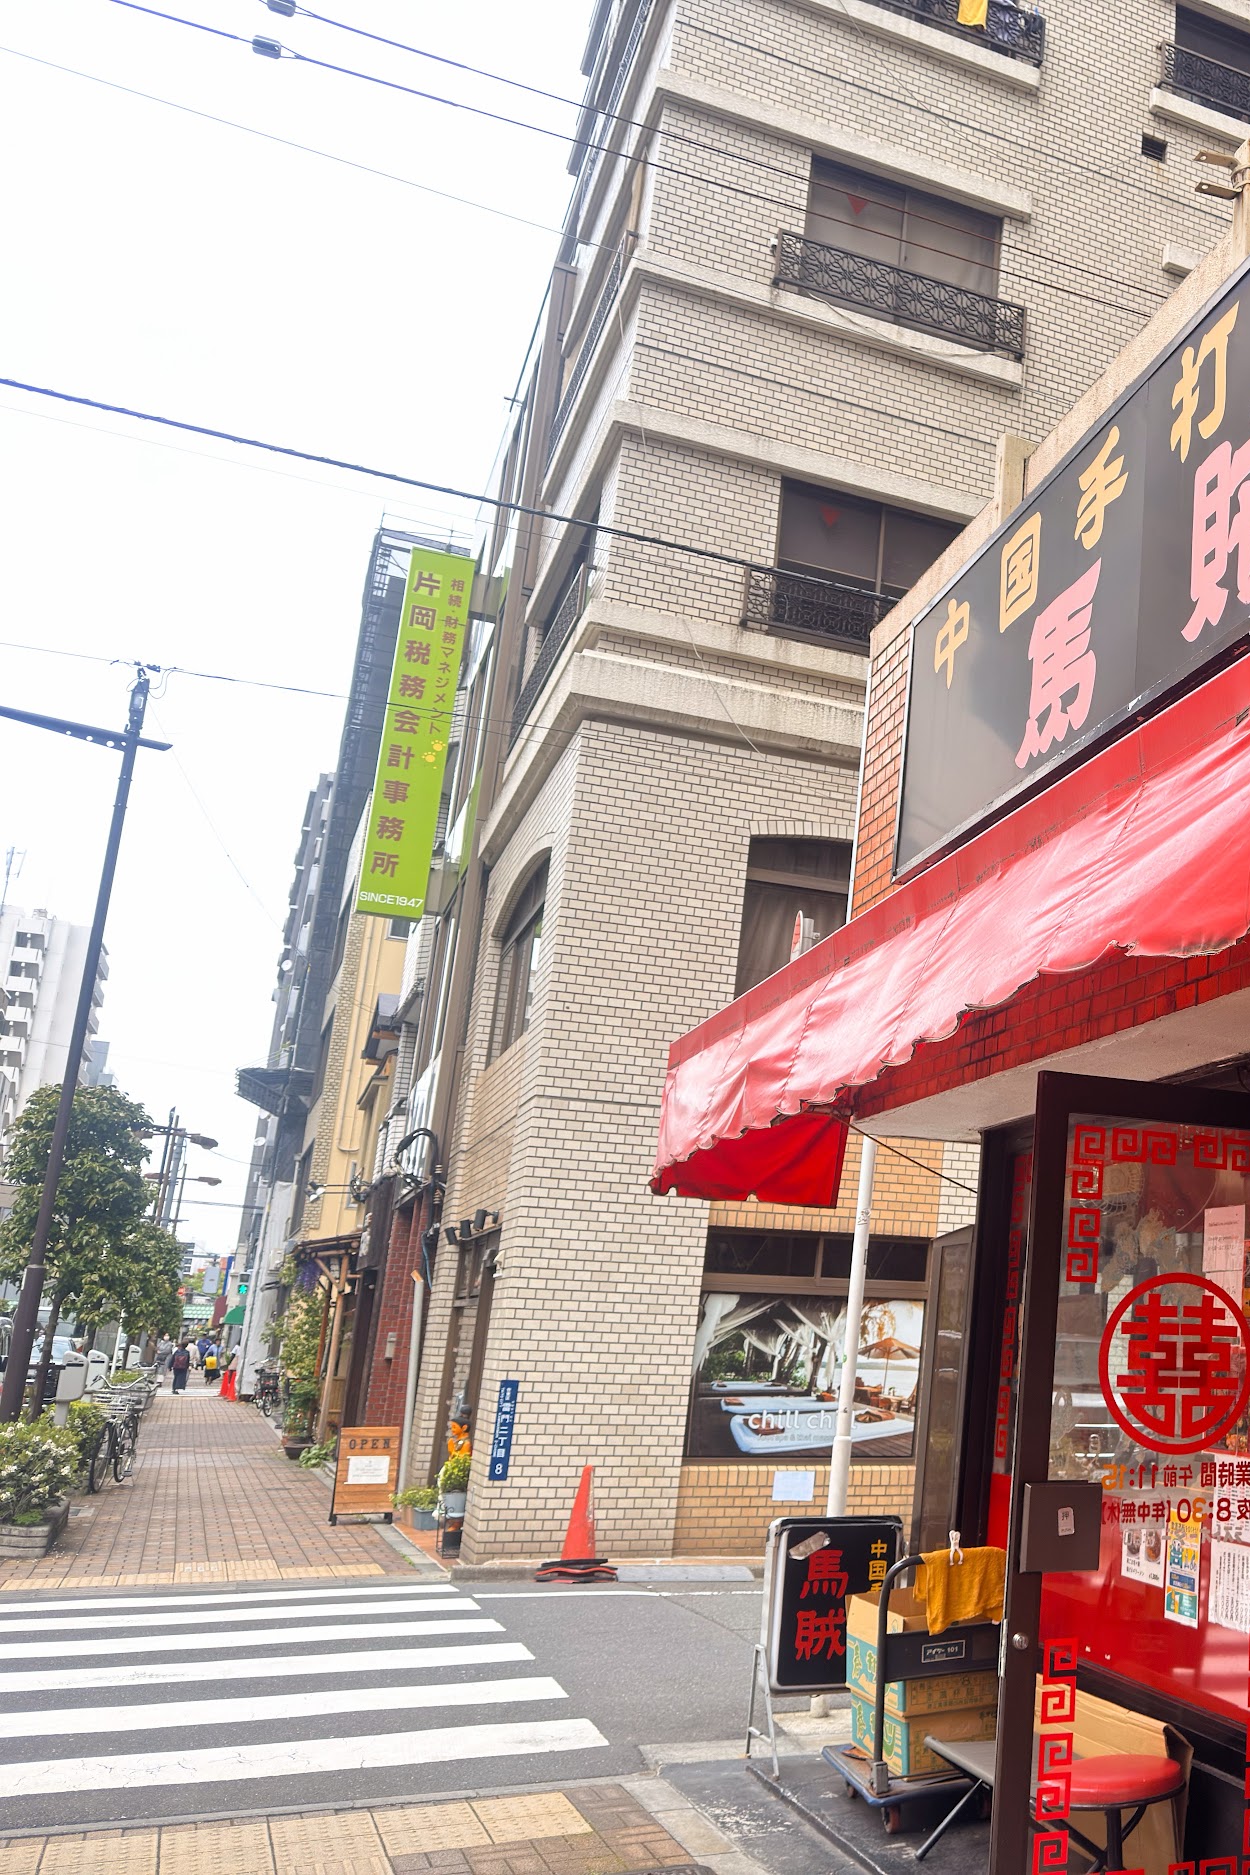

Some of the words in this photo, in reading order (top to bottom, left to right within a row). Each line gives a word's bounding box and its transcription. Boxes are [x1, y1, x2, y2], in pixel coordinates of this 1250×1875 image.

[370, 570, 441, 878] 片岡税務会計事務所
[748, 1409, 800, 1430] chill
[807, 1409, 857, 1430] chl
[349, 1438, 391, 1450] OPEN
[495, 1463, 503, 1475] 8
[794, 1549, 849, 1661] 馬賊
